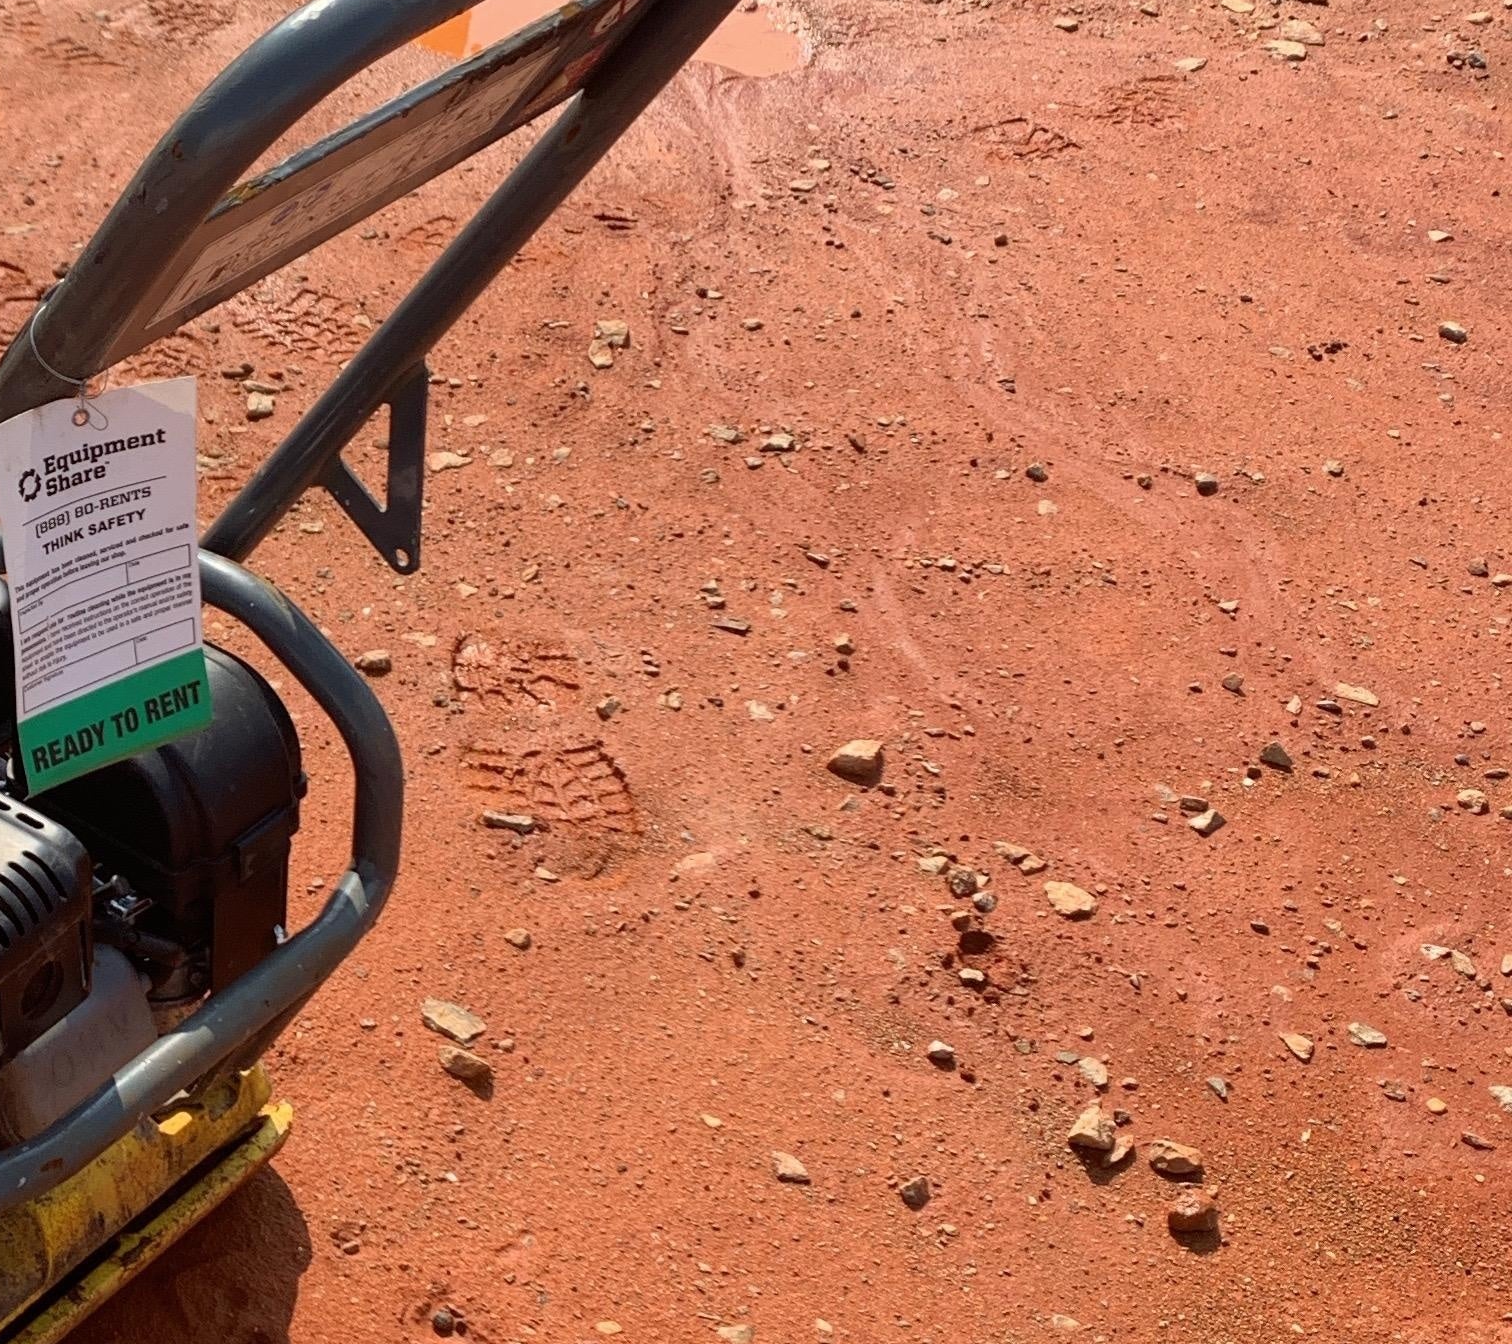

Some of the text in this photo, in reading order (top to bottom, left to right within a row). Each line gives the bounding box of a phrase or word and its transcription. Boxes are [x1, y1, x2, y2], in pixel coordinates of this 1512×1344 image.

[43, 428, 166, 475] Equipment
[45, 464, 107, 497] Share
[35, 486, 152, 538] (888) 80-RENTS
[42, 508, 146, 555] THINK SAFETY
[31, 680, 201, 773] READY TO RENT
